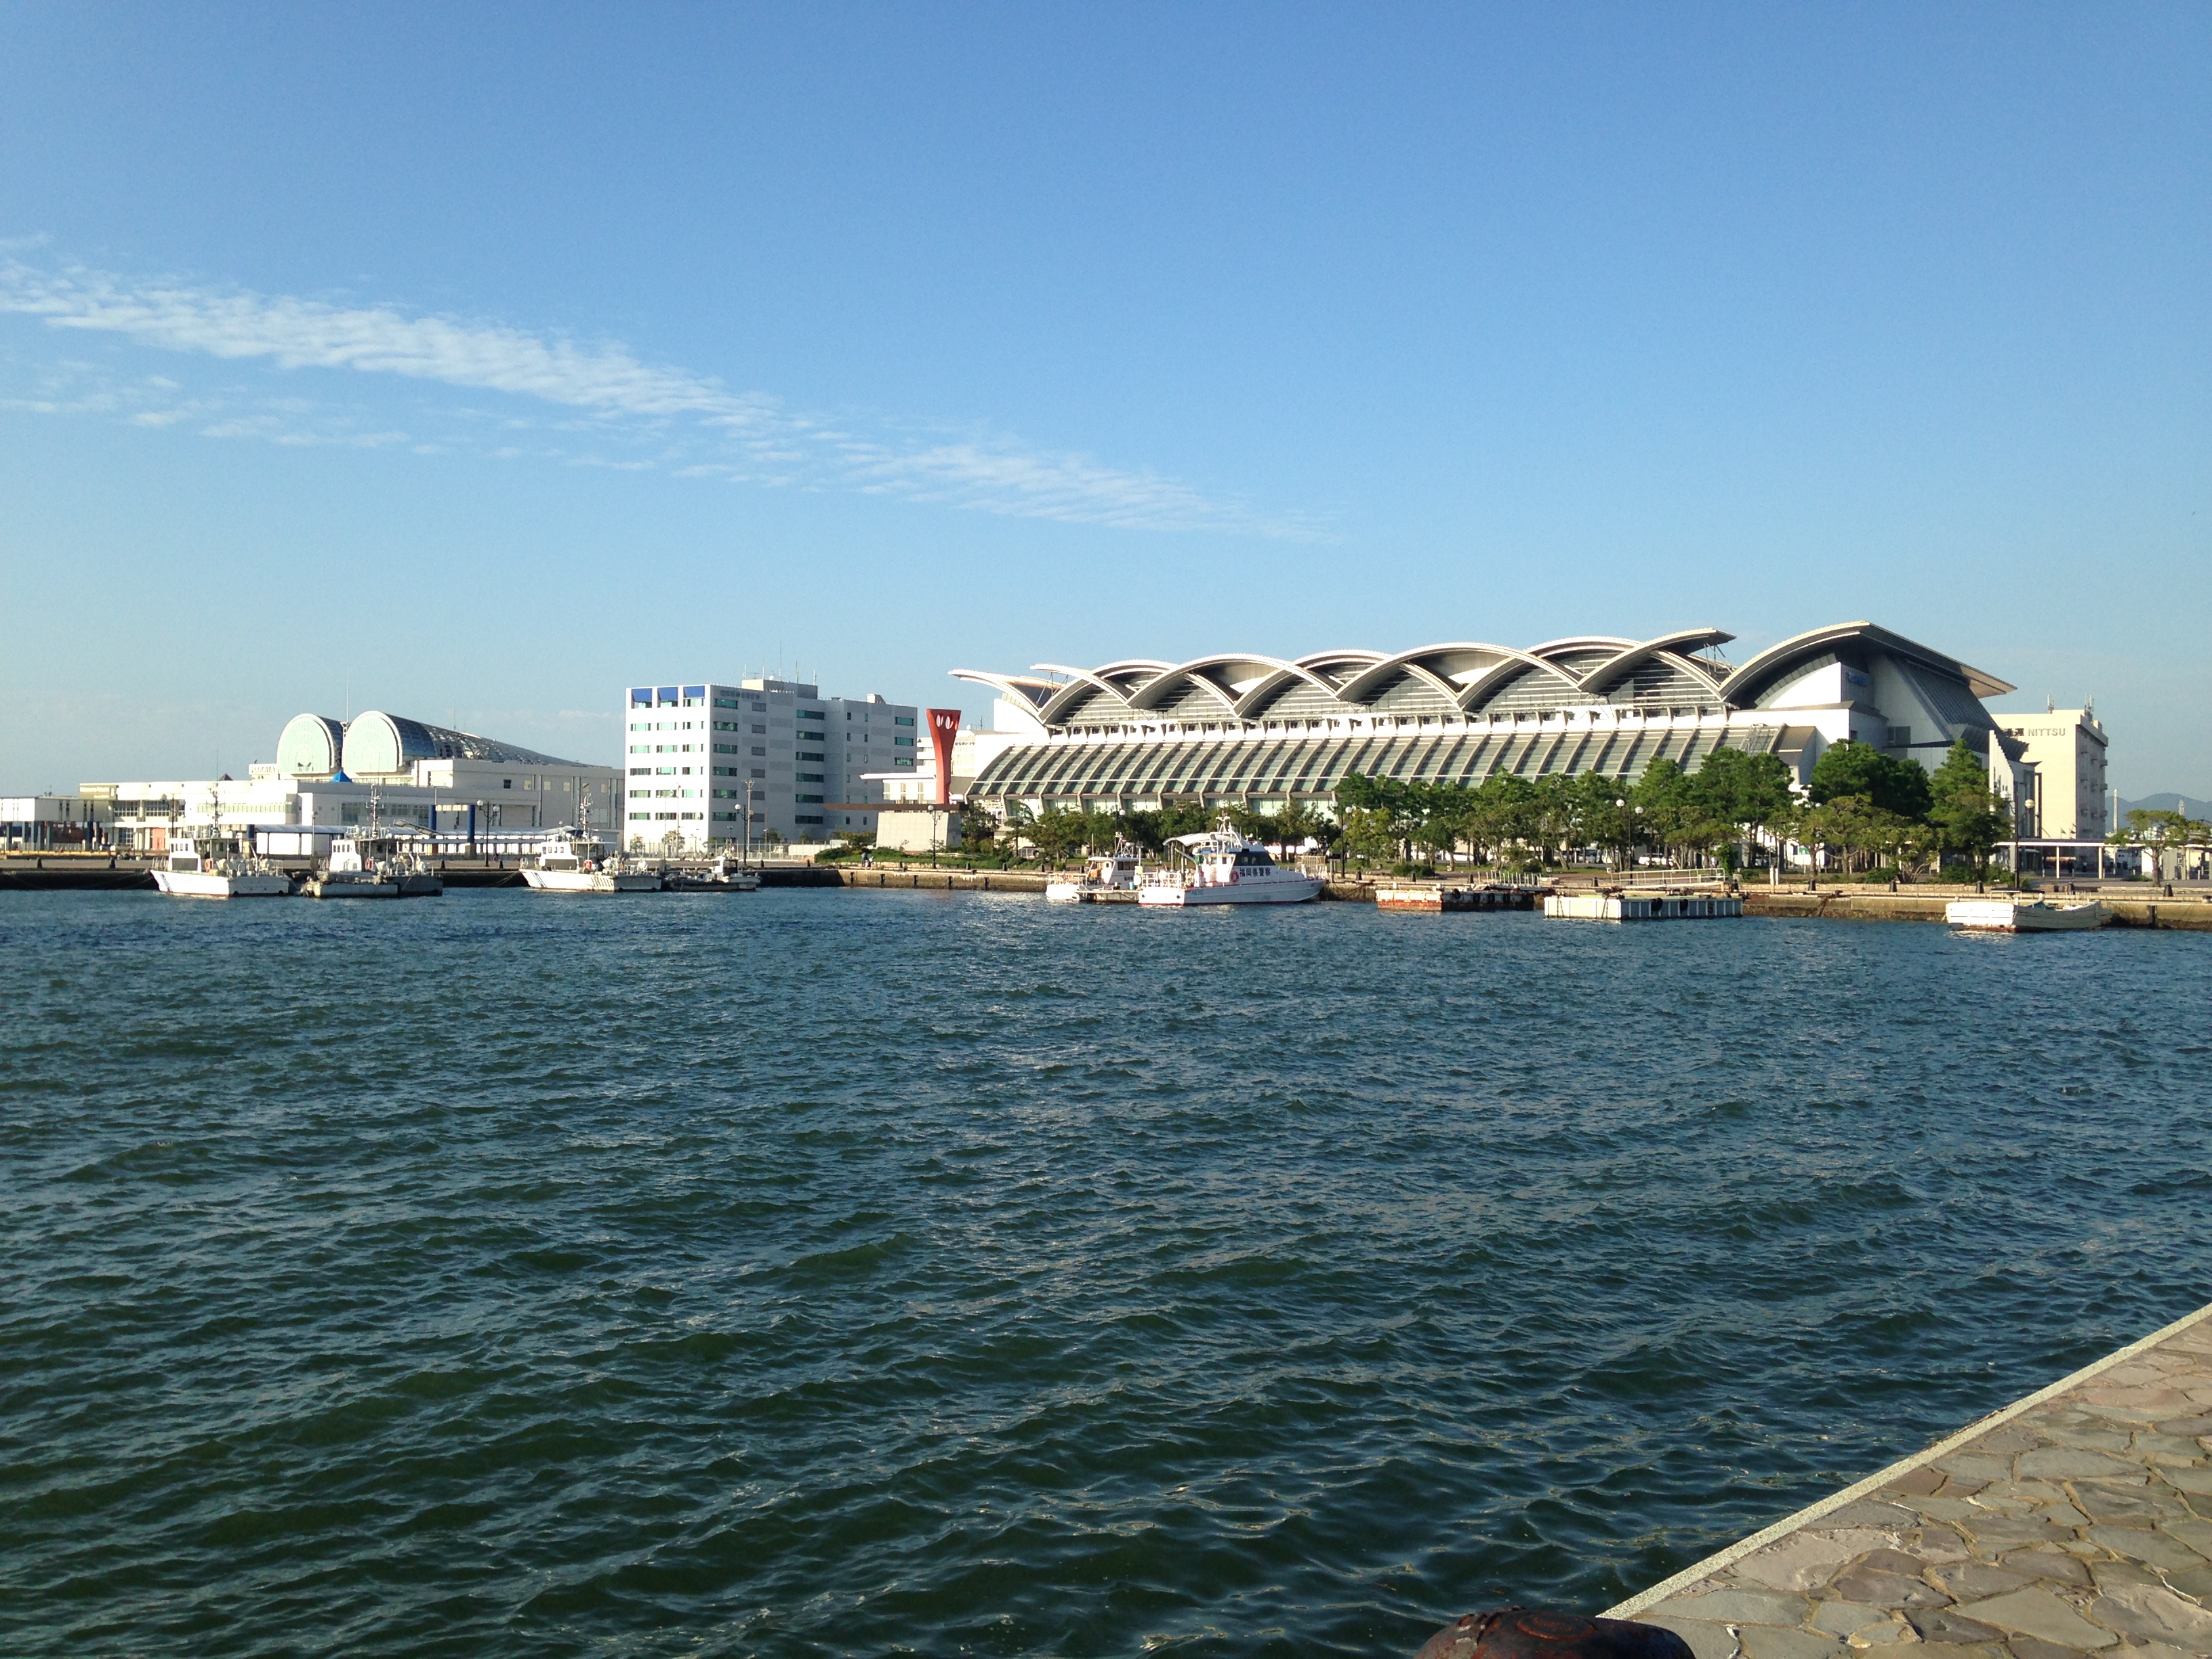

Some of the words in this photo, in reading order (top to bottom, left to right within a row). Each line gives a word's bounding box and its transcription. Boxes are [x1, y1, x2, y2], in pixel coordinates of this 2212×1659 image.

[2028, 728, 2066, 737] NITTSU
[1240, 867, 1271, 877] 福岡県警察
